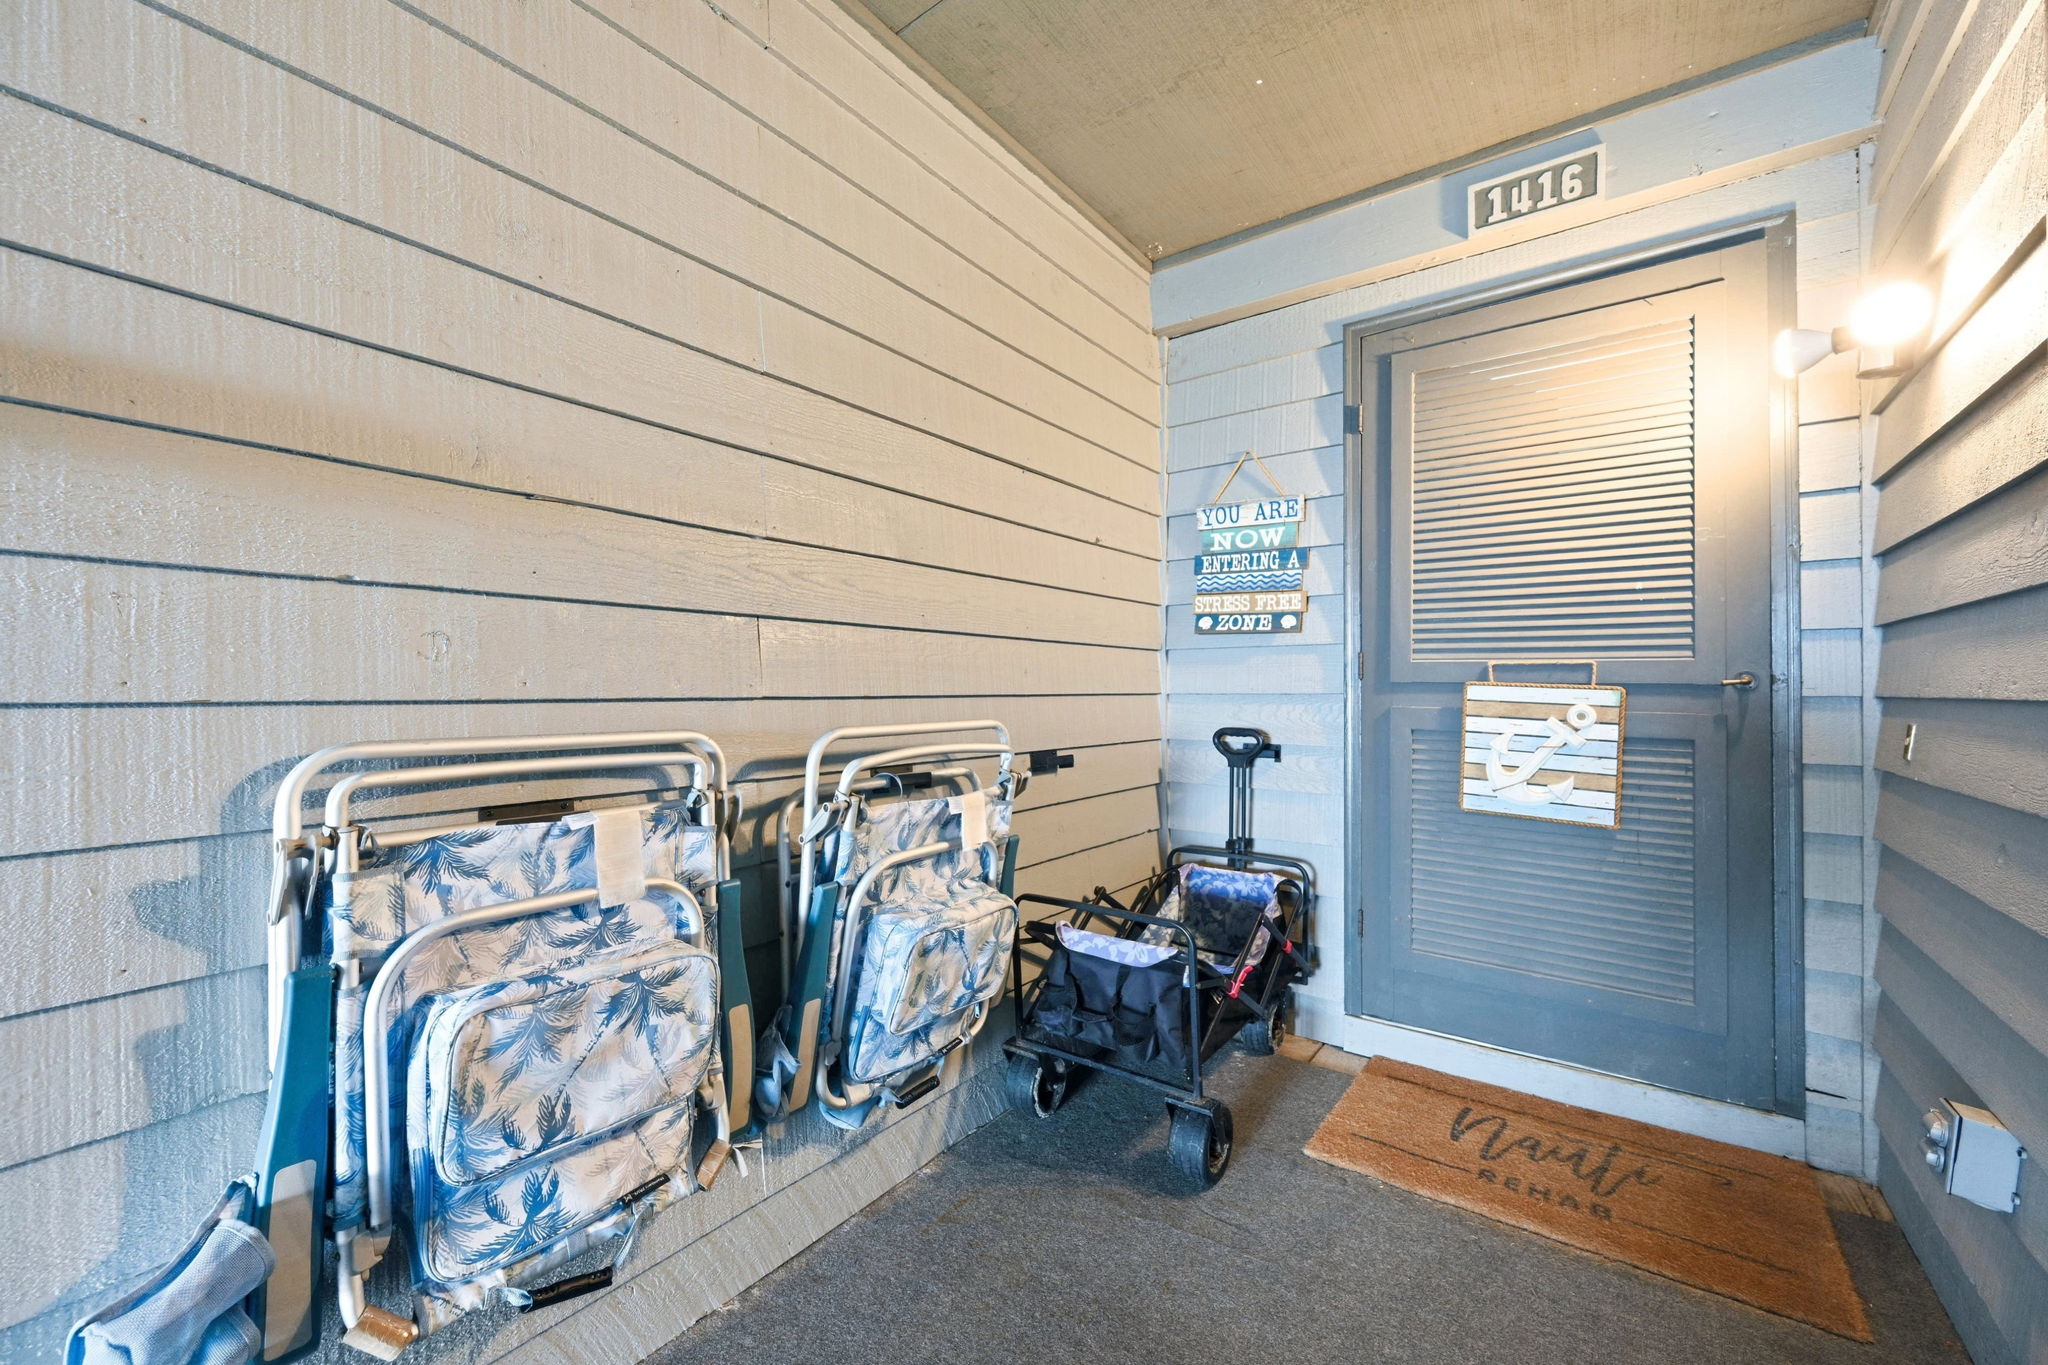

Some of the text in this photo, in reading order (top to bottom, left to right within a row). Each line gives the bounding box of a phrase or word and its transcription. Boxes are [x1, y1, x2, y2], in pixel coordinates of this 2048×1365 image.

[1487, 163, 1584, 224] 1416
[1201, 498, 1299, 527] YOU ARE
[1209, 526, 1286, 551] NOW
[1201, 550, 1300, 574] ENTERING A
[1194, 593, 1302, 613] STRESS FREE
[1215, 614, 1273, 632] ZONE
